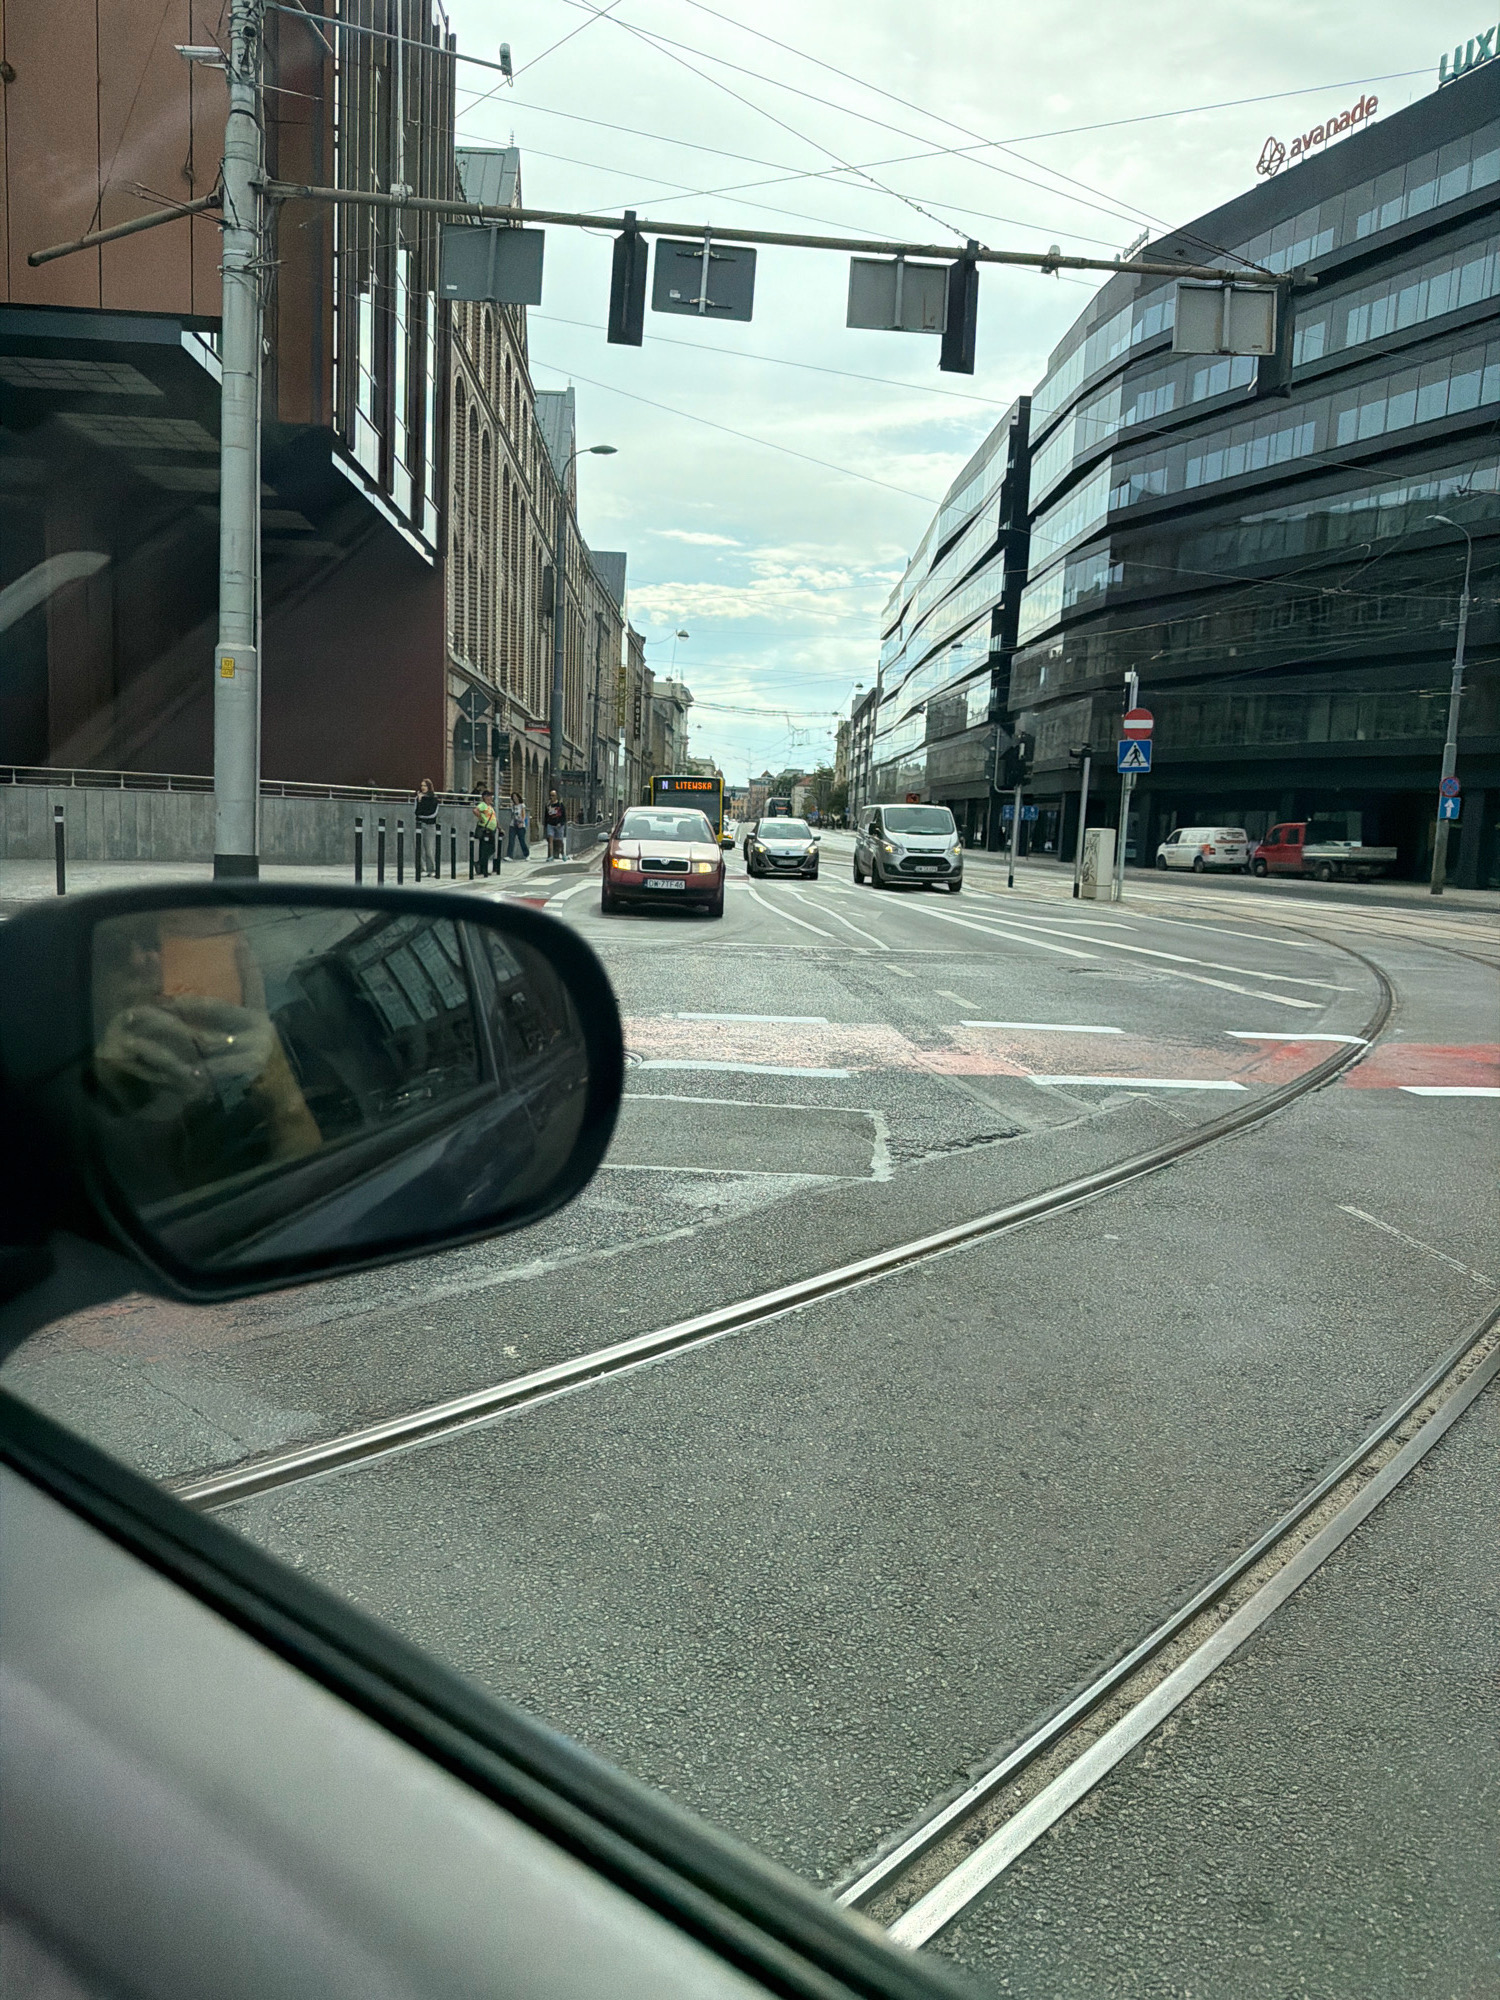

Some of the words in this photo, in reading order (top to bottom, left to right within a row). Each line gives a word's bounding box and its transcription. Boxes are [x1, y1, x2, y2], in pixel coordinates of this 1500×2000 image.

[1439, 22, 1500, 83] LUX
[1290, 94, 1379, 158] avanade
[661, 780, 669, 790] N
[675, 781, 713, 790] LITEWSKA
